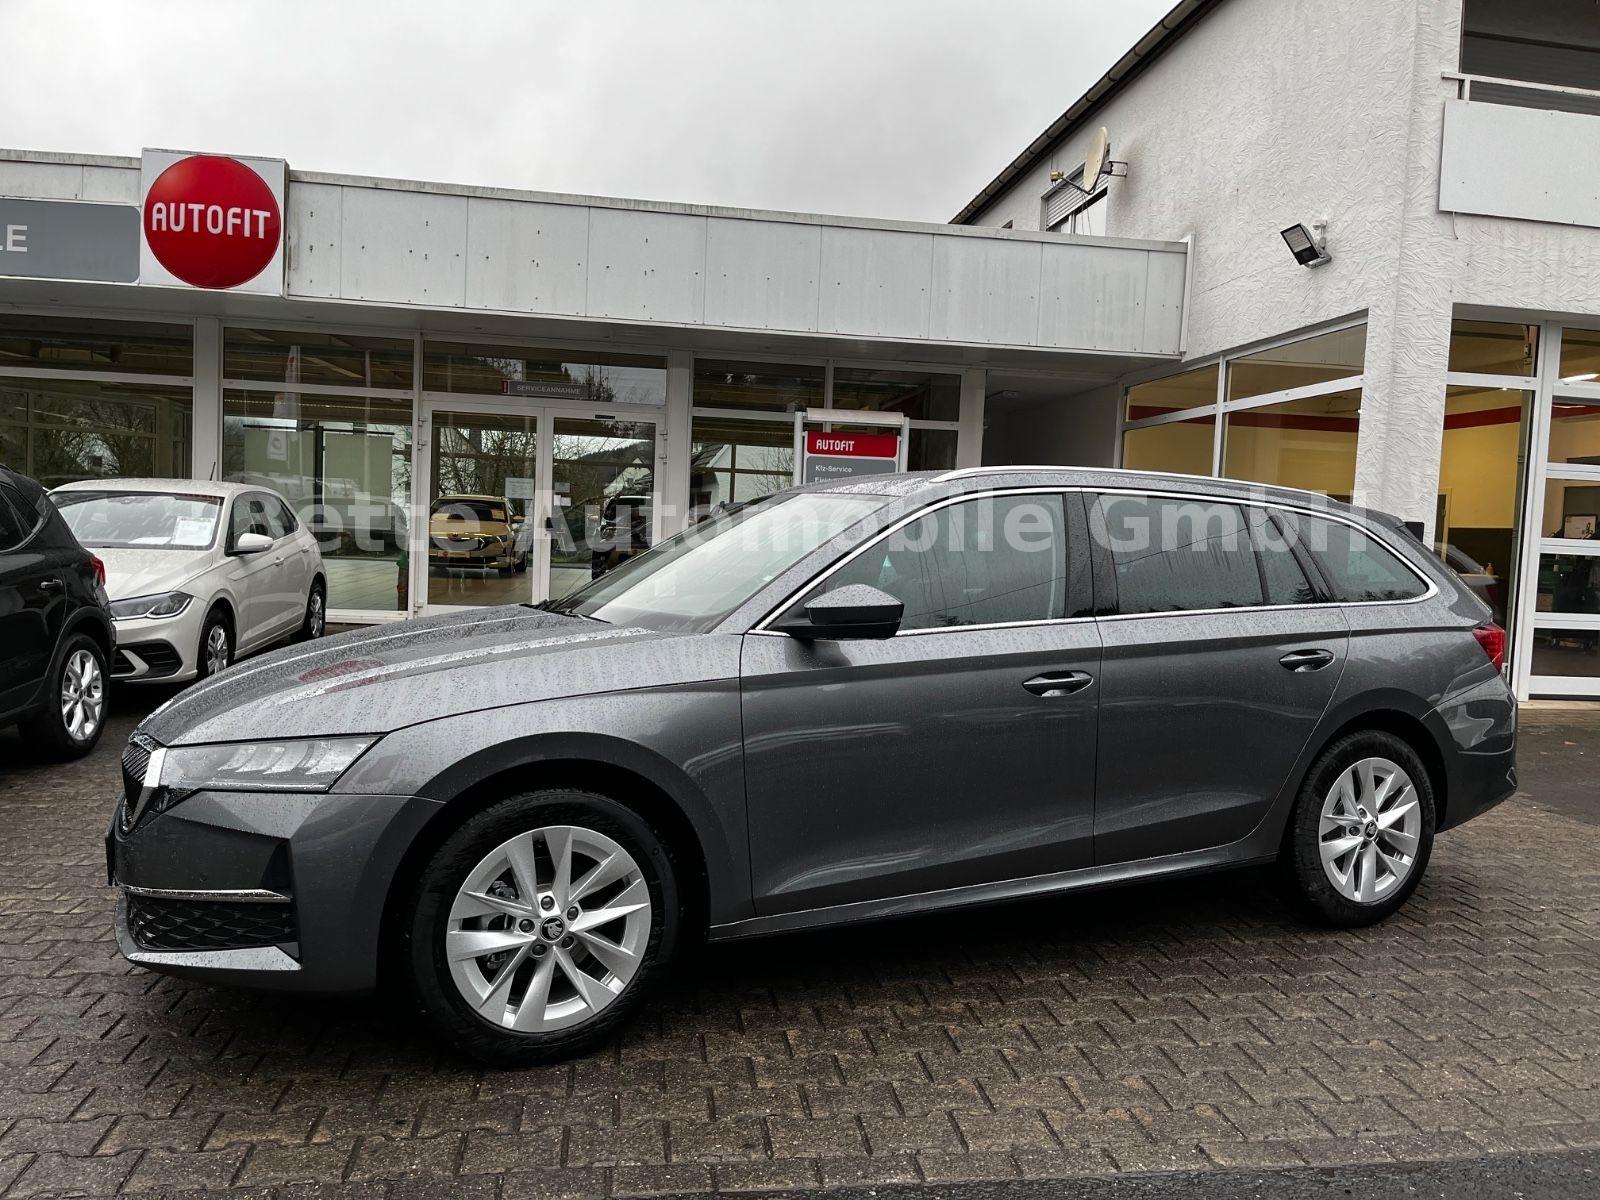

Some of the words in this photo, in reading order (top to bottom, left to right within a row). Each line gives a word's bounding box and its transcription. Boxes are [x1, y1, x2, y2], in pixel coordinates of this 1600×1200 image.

[151, 202, 271, 239] AUTOFIT
[517, 385, 580, 394] SERVICEANNAHME
[816, 439, 855, 451] AUTOFIT
[815, 464, 853, 473] Kfz-Service
